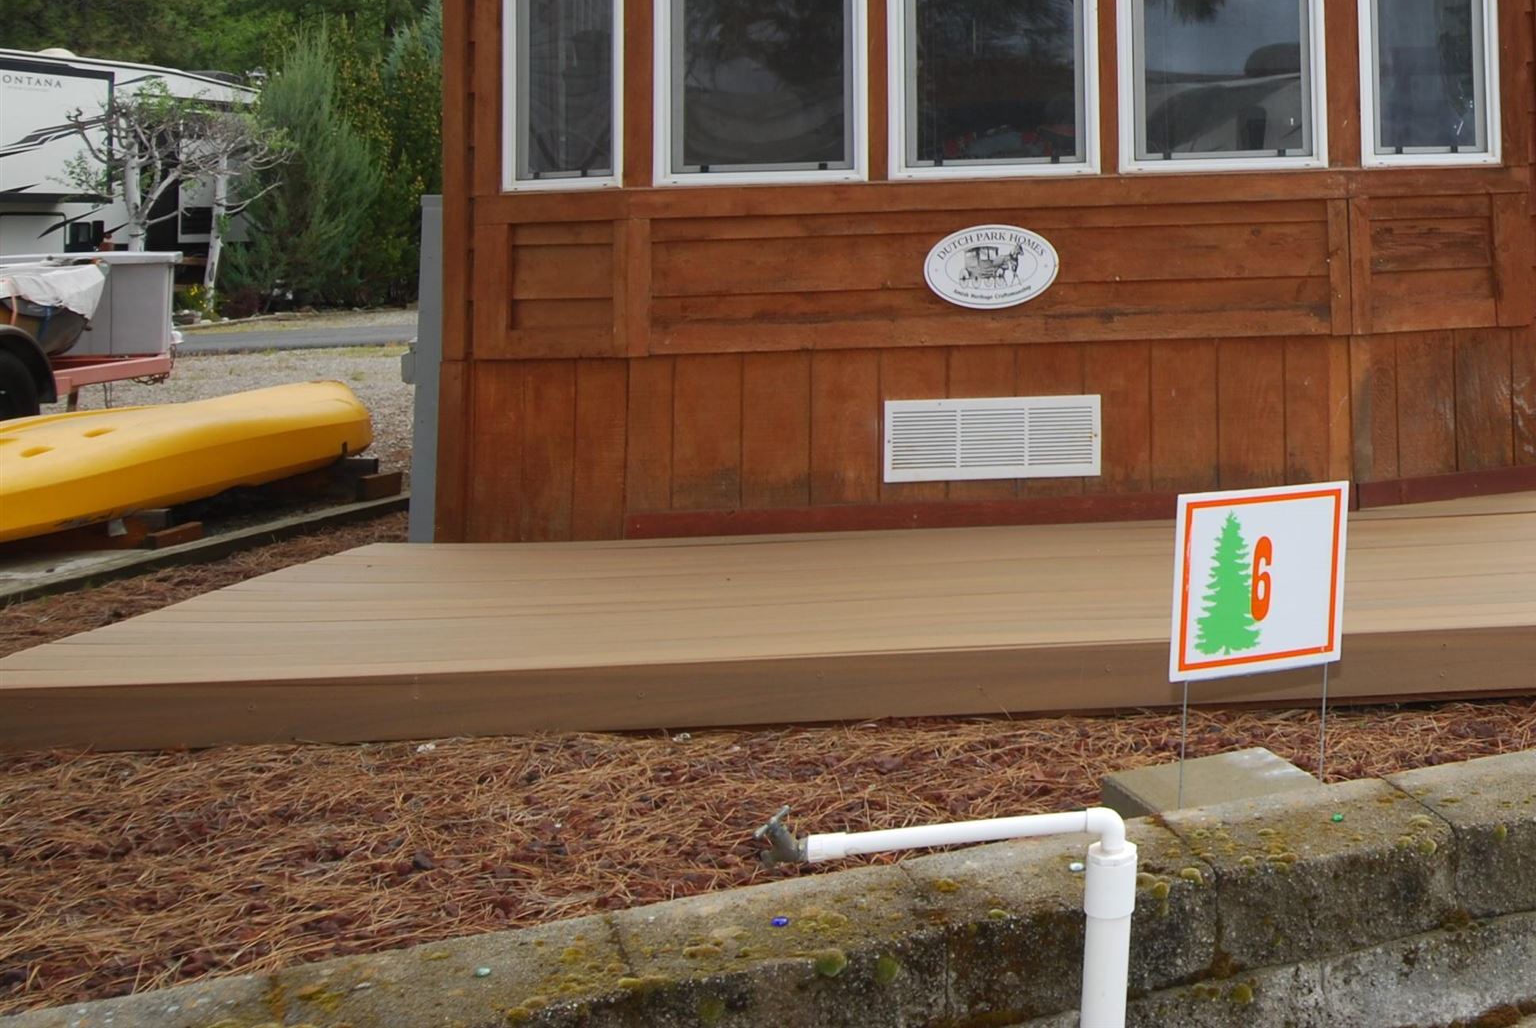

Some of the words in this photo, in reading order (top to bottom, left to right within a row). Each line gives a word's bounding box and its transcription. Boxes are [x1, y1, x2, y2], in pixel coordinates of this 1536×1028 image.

[938, 234, 973, 260] DUTCH
[976, 232, 1006, 242] PARK
[1009, 233, 1046, 257] HOMES
[1250, 535, 1273, 621] 6
